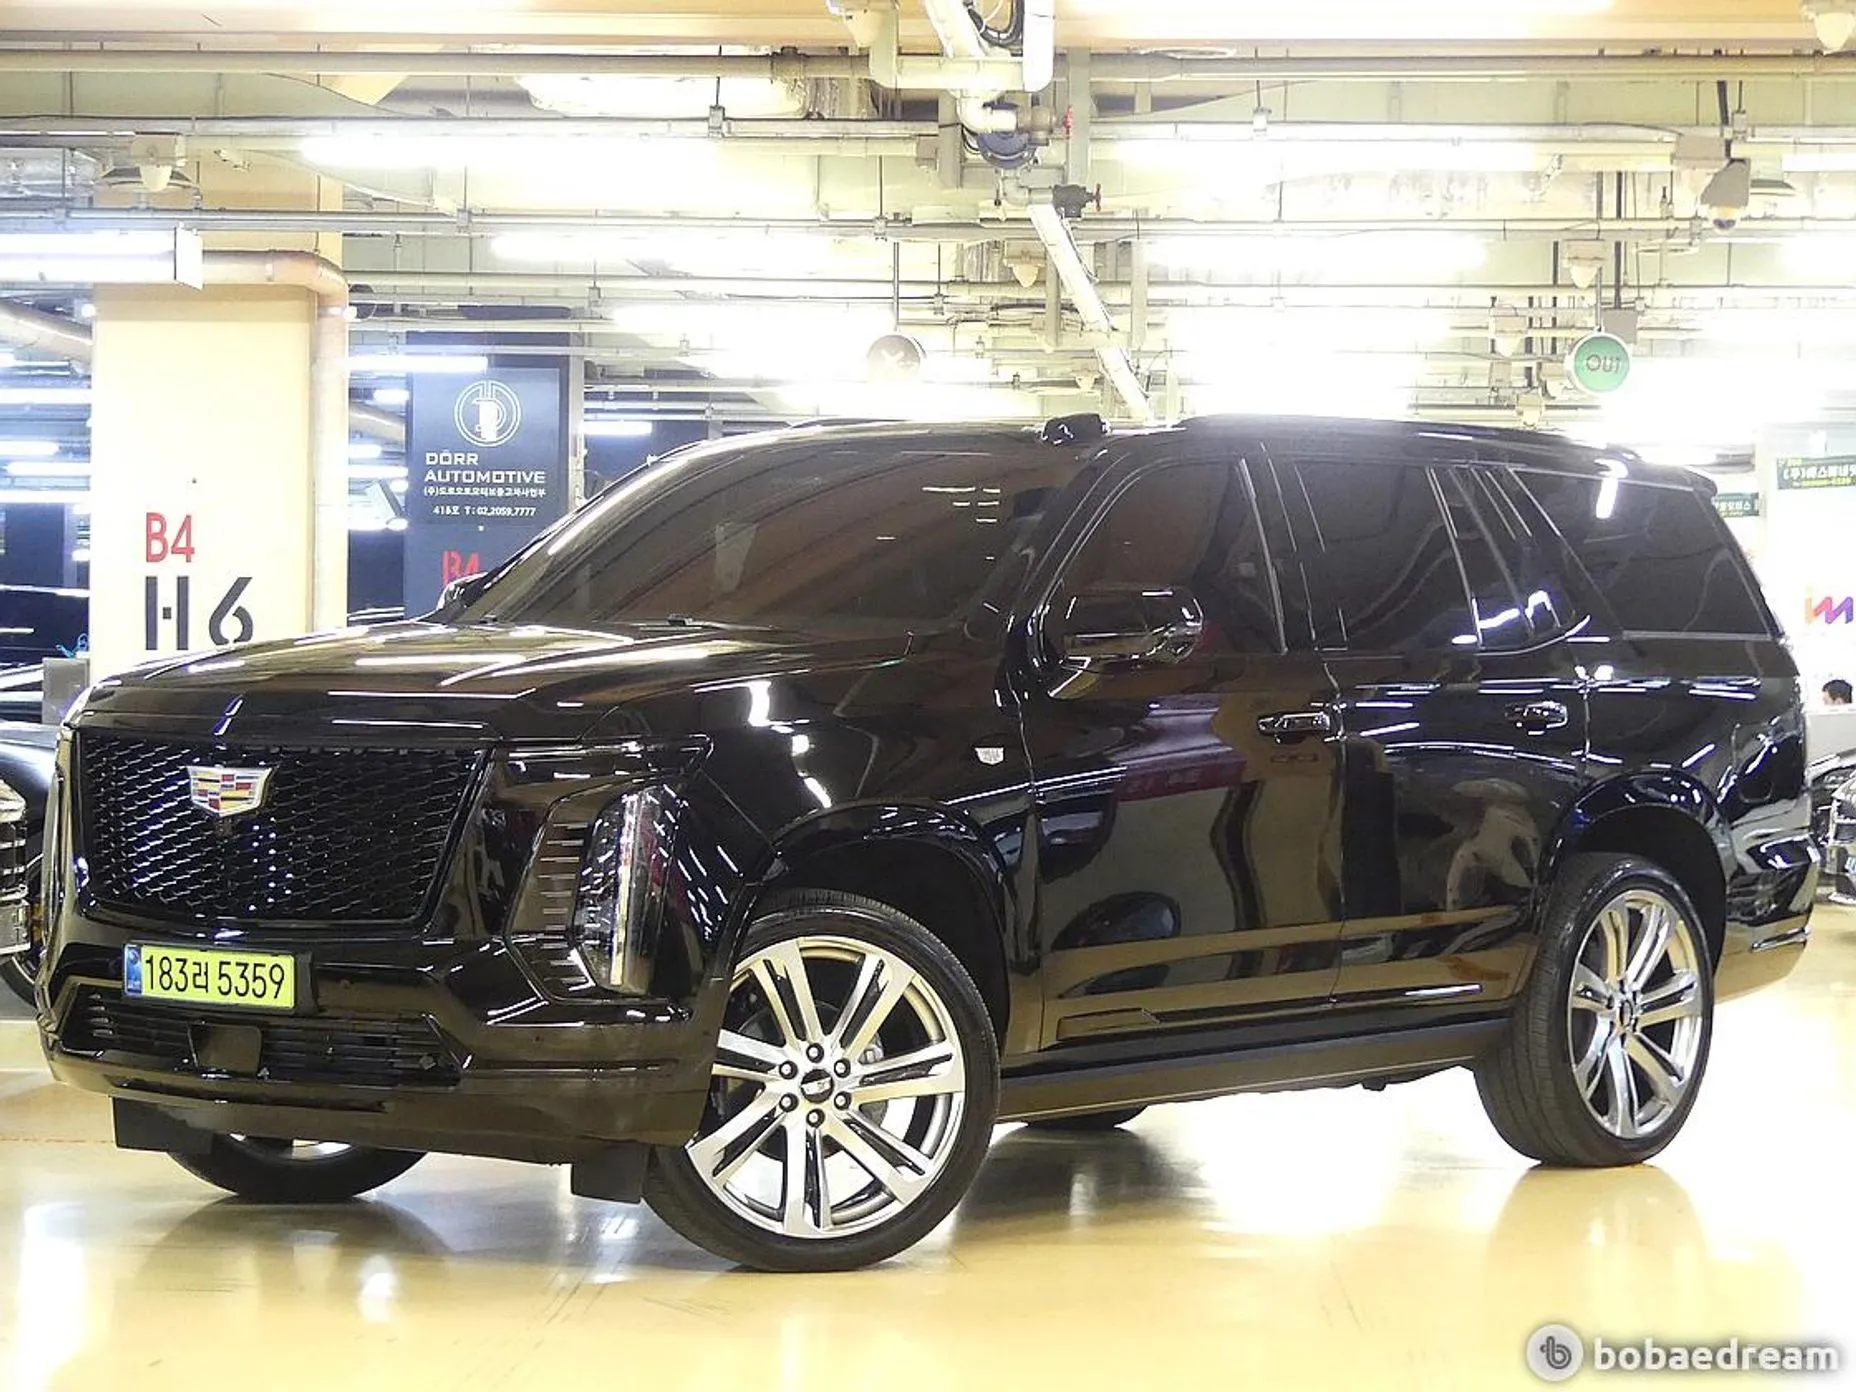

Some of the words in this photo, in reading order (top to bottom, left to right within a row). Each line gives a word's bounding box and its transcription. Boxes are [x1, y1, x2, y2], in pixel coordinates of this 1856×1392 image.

[424, 470, 546, 484] AUTOMOTIVE
[145, 512, 195, 563] B4
[145, 955, 209, 993] 183러
[217, 960, 285, 999] 5359
